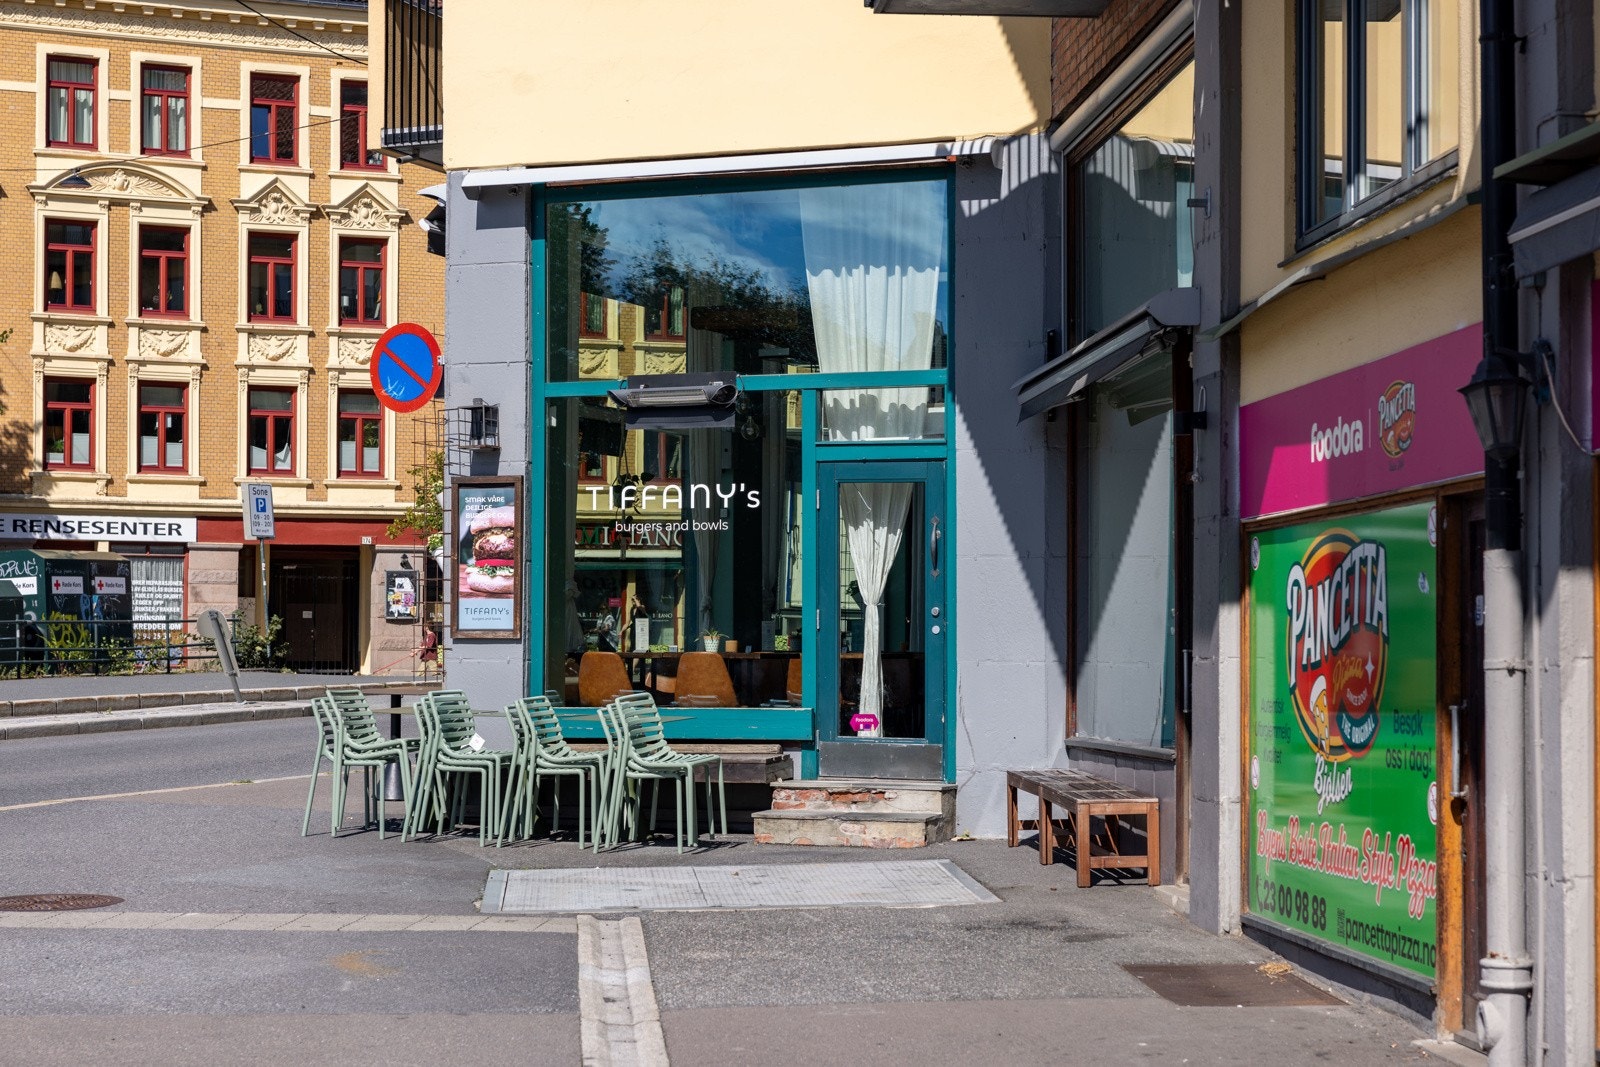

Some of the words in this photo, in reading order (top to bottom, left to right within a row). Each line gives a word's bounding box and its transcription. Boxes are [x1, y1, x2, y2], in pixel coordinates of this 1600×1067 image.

[1378, 382, 1416, 438] PANCETTA
[1311, 416, 1363, 463] foodora
[252, 487, 268, 495] Sone
[257, 499, 264, 511] P
[487, 495, 505, 503] VÅRE
[586, 483, 760, 511] TIFFANY's
[12, 519, 182, 537] RENSESENTER
[615, 521, 662, 534] burgers
[665, 520, 689, 531] and
[692, 519, 729, 531] bowls
[464, 607, 510, 615] TIFFANY's
[1287, 541, 1389, 692] PANCETTA
[1332, 653, 1364, 704] Pizza
[1342, 713, 1351, 739] THE
[1351, 714, 1375, 744] ORIGINAL
[1393, 709, 1423, 735] Besøk
[1385, 748, 1402, 769] oss
[1409, 747, 1432, 779] dag!
[1257, 809, 1287, 877] Byens
[1288, 815, 1318, 871] Beste
[1318, 821, 1360, 880] Italian
[1361, 827, 1395, 906] Style
[1396, 834, 1437, 920] Pizza
[1264, 879, 1276, 913] 23
[1279, 884, 1292, 918] 00
[1295, 889, 1309, 924] 98
[1312, 895, 1327, 931] 88
[1345, 917, 1437, 968] pancettapizza.no
